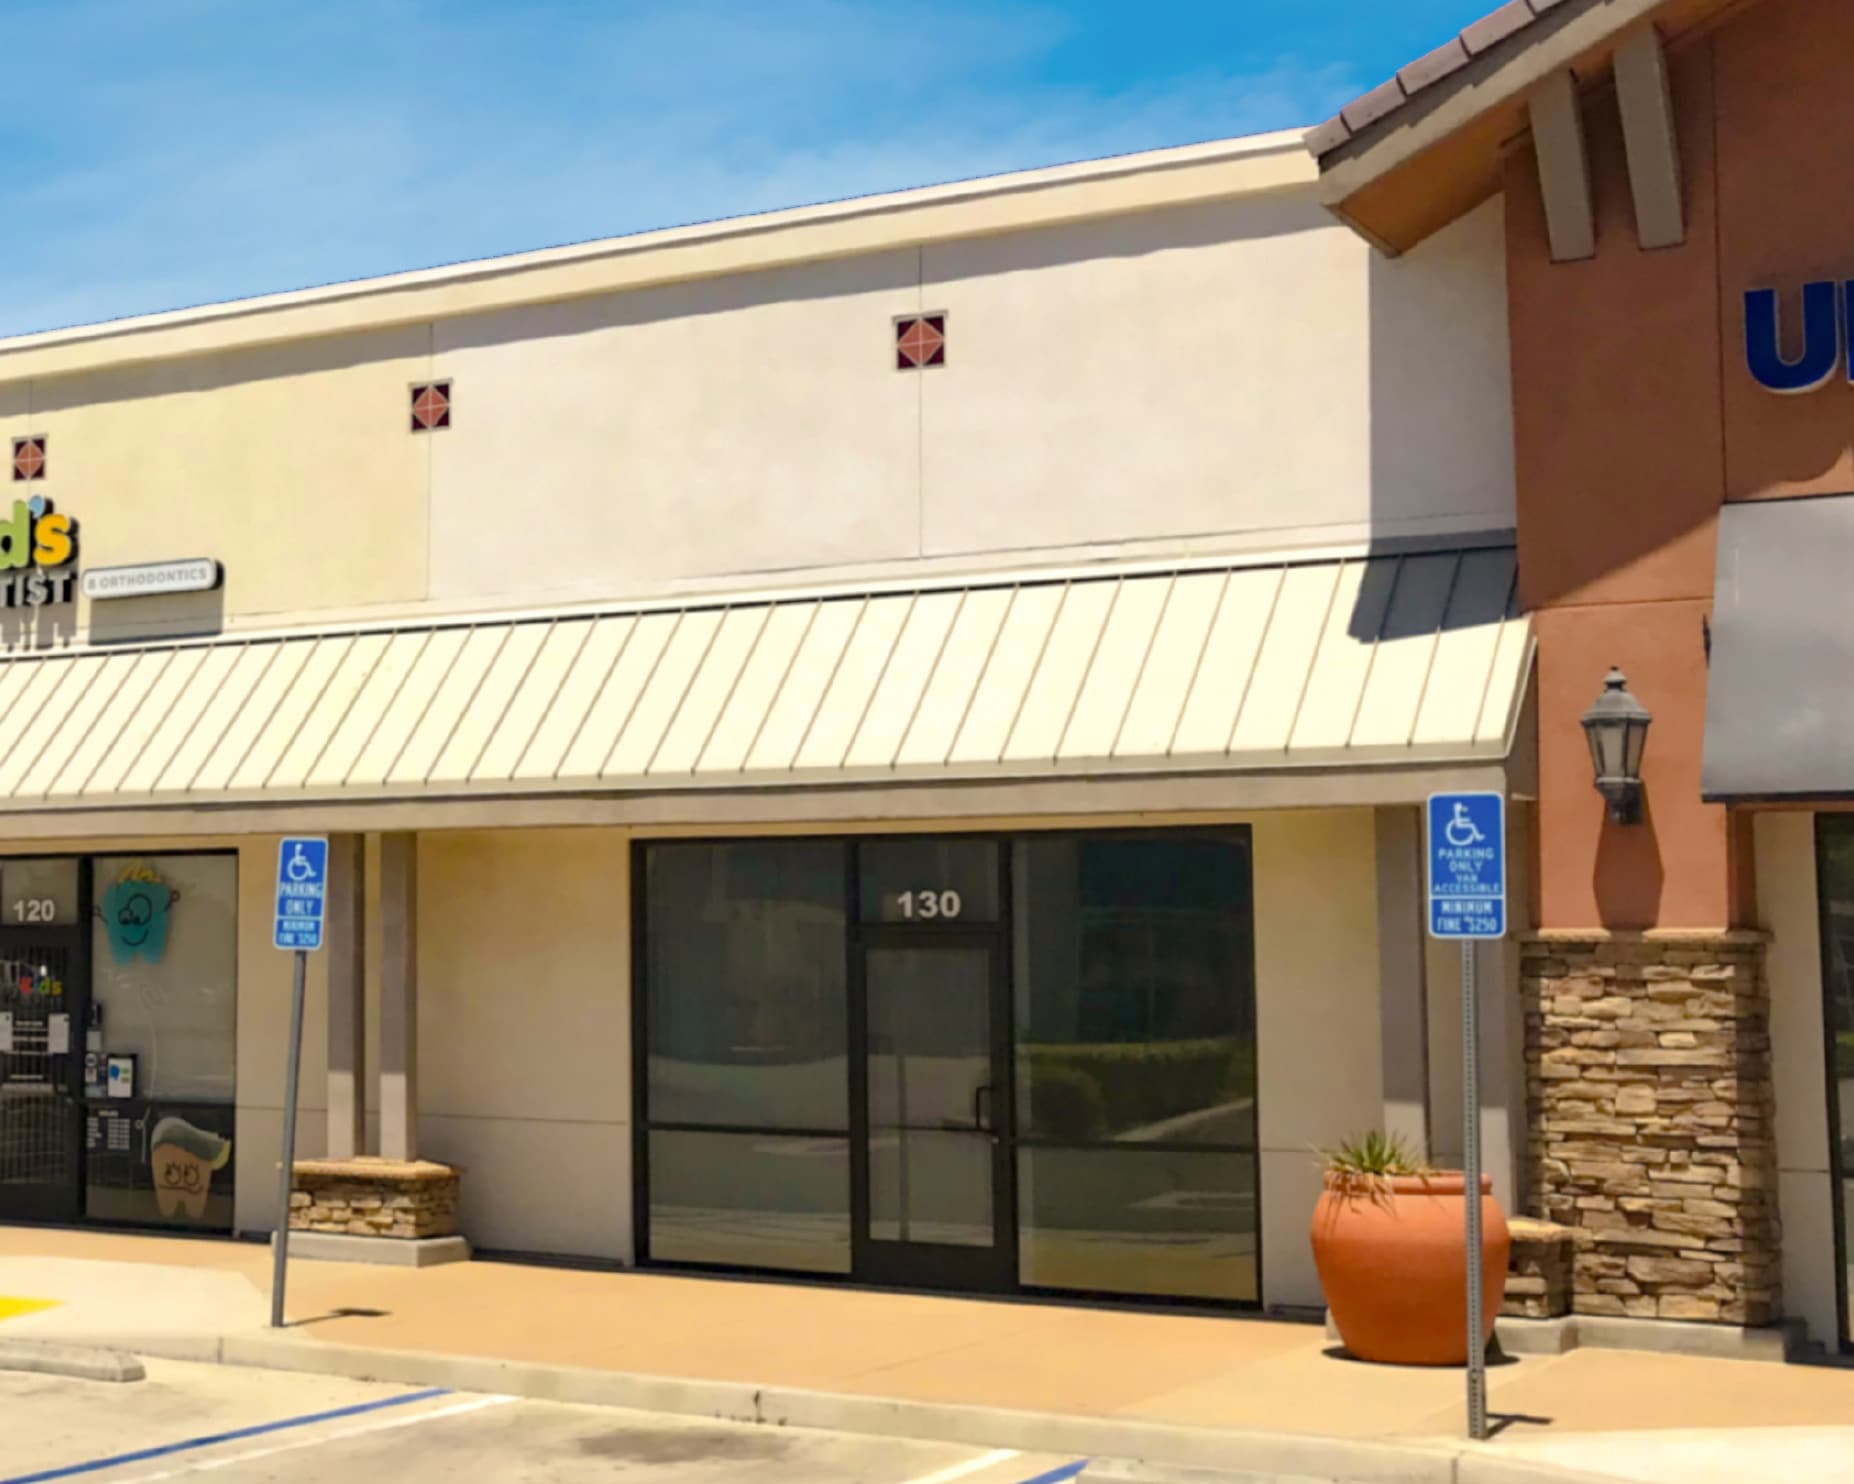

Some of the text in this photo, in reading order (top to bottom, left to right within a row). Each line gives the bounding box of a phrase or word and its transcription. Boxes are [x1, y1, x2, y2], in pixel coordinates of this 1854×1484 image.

[1744, 279, 1854, 390] U
[100, 568, 208, 590] ORTHODONTICS
[1438, 847, 1494, 860] PARKING
[1449, 861, 1483, 872] ONLY
[1456, 874, 1478, 883] VAN
[280, 882, 323, 898] PARKING
[1434, 883, 1500, 893] ACCESSIBLE
[13, 900, 55, 921] 120
[286, 899, 314, 914] ONLY
[897, 890, 961, 918] 130
[1441, 901, 1493, 914] MINIMUM
[1437, 917, 1461, 931] FINE
